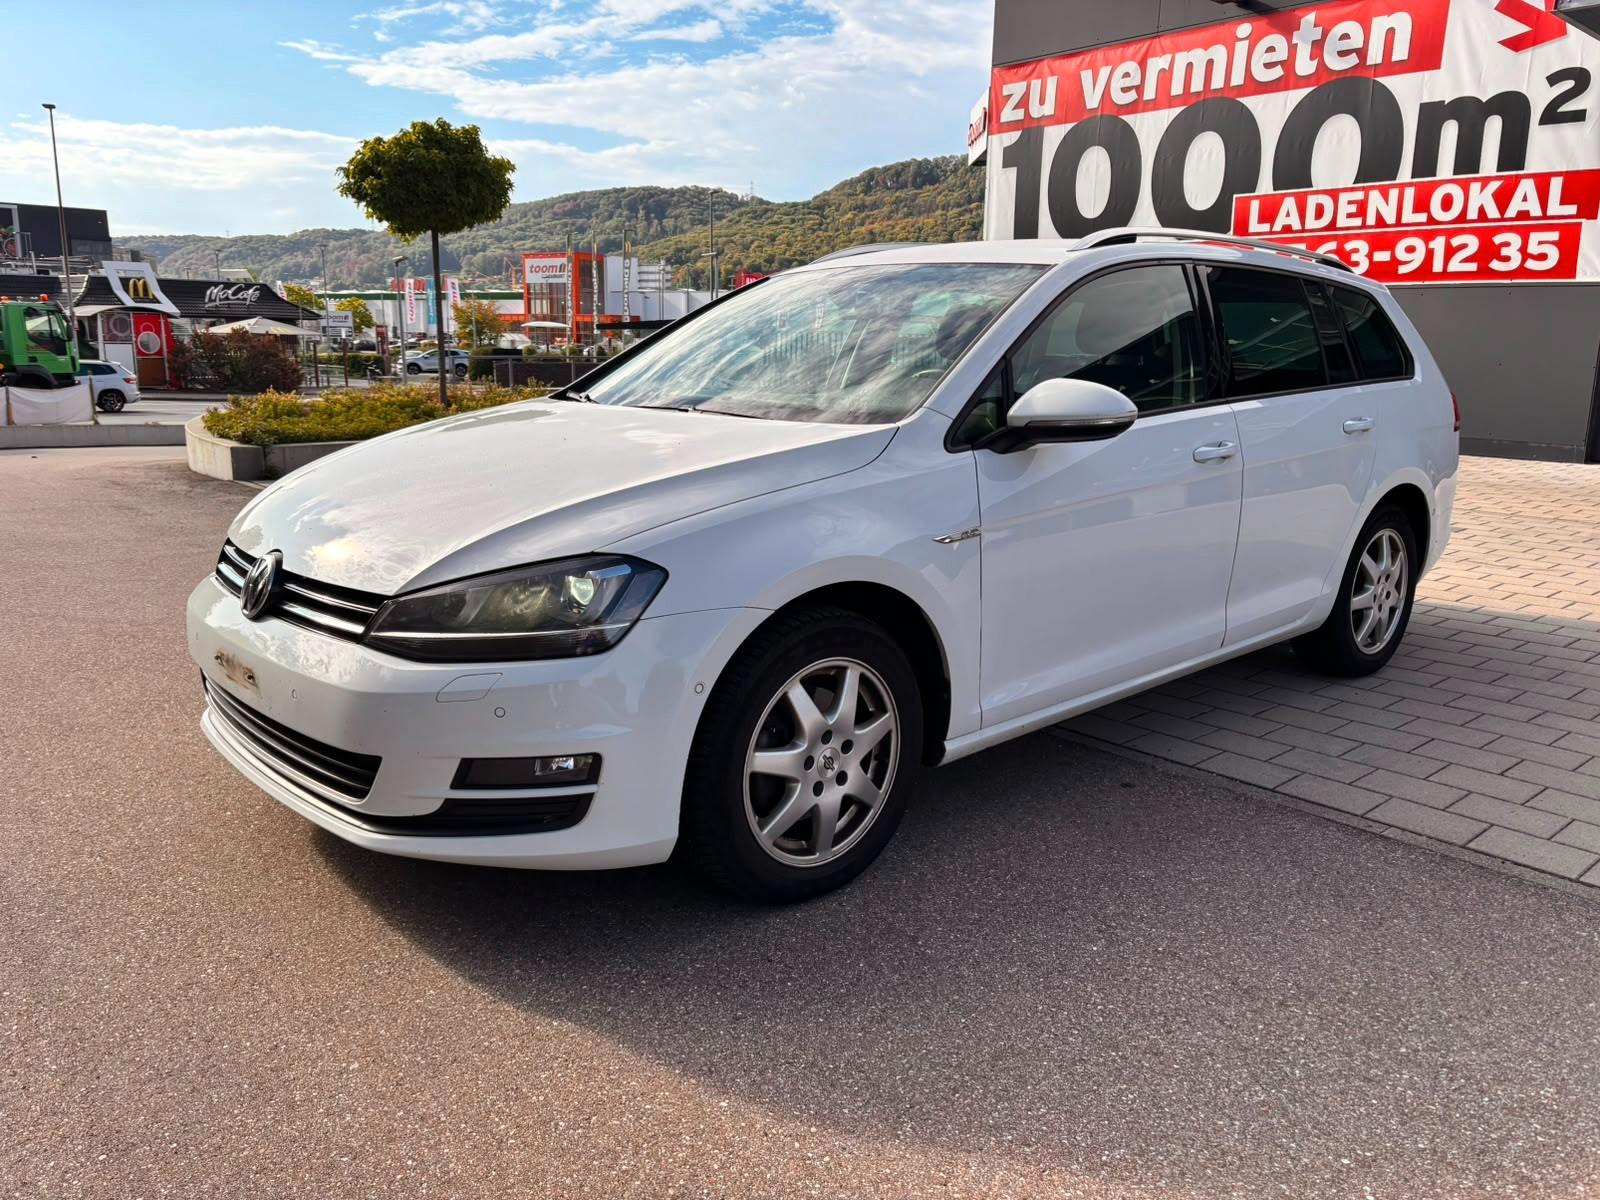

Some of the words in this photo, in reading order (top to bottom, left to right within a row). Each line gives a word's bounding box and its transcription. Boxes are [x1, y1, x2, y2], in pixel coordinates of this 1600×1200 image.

[1000, 76, 1058, 122] zu
[1080, 10, 1413, 110] vermieten
[1248, 176, 1578, 233] LADENLOKAL
[529, 264, 558, 273] toom
